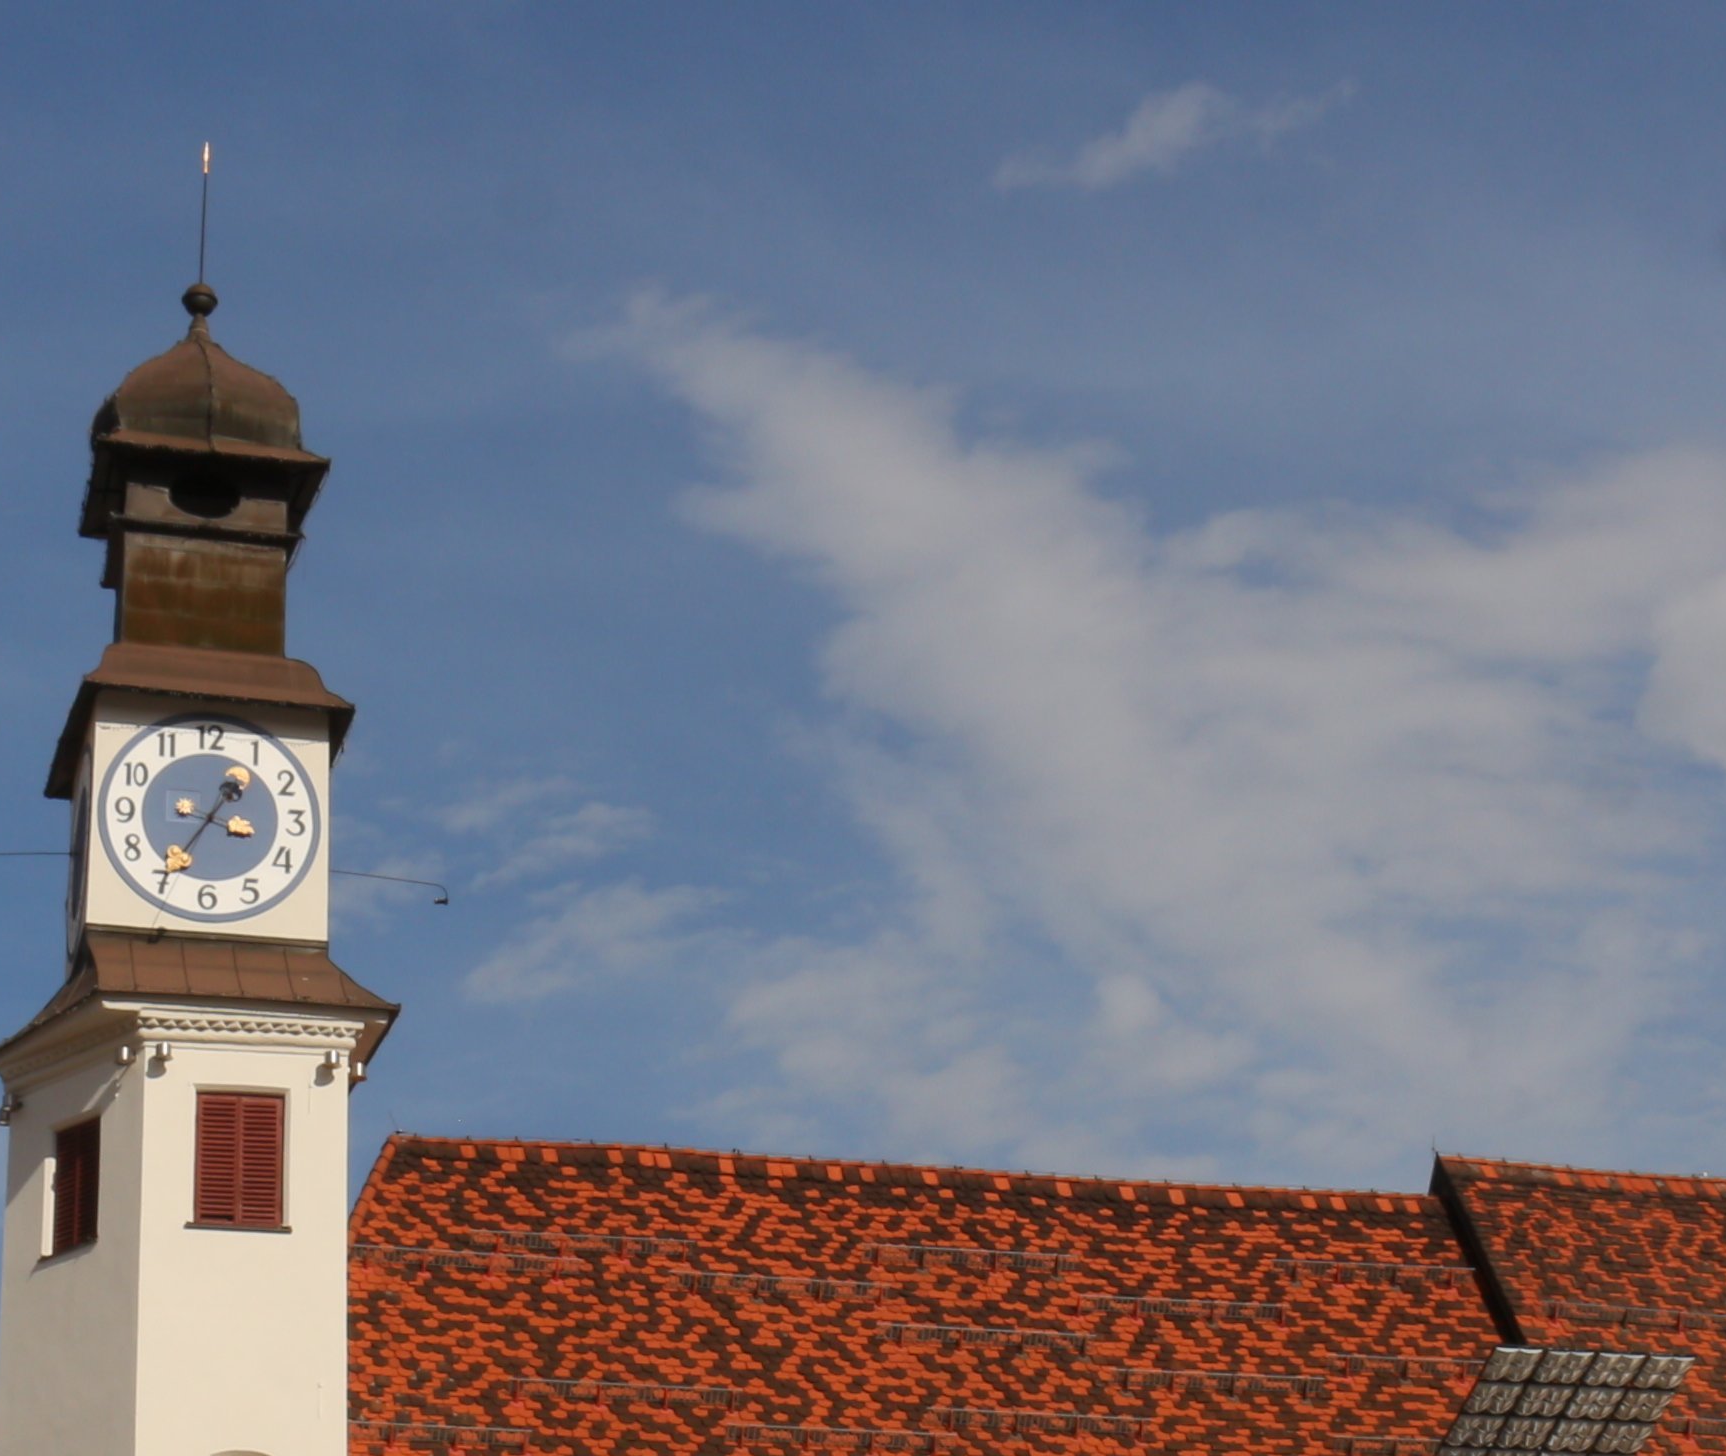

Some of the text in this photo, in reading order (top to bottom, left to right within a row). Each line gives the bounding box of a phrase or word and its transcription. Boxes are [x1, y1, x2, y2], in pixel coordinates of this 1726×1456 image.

[157, 732, 177, 758] 11
[196, 725, 225, 752] 12
[250, 741, 261, 766] 1
[124, 762, 149, 787] 10
[277, 770, 296, 797] 2
[115, 796, 136, 823] 9
[287, 809, 306, 836] 3
[124, 833, 142, 862] 8
[272, 845, 293, 874] 4
[152, 867, 170, 894] 7
[239, 878, 260, 905] 5
[197, 884, 218, 910] 6
